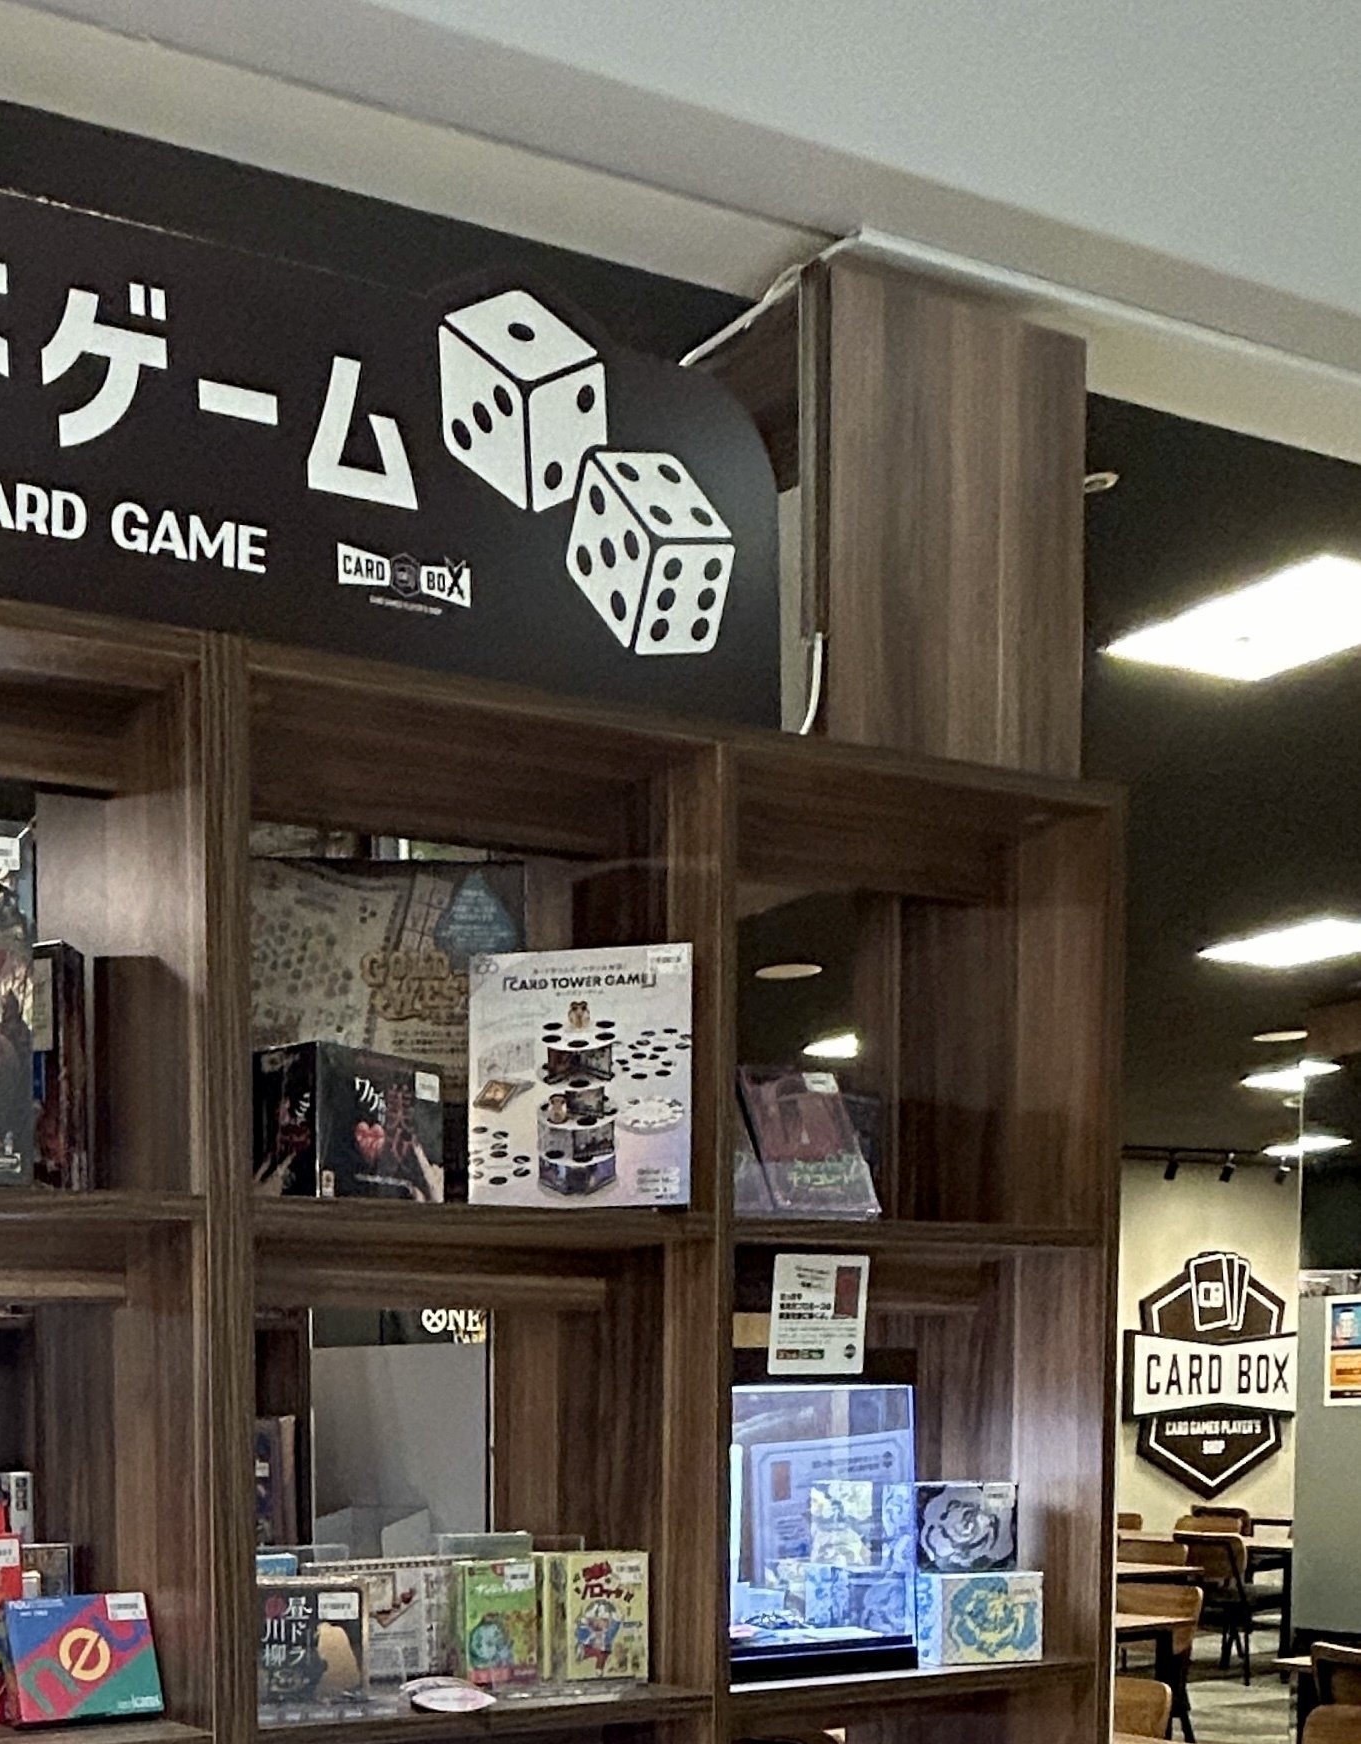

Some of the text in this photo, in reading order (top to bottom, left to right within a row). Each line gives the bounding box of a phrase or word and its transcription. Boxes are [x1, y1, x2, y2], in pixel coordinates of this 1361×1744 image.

[111, 502, 268, 575] GAME
[342, 554, 466, 601] CARD BOX
[552, 975, 602, 989] TOWER
[1146, 1352, 1290, 1395] CARD BOX
[260, 1620, 287, 1667] 川柳
[284, 1596, 314, 1665] 昼ドラ
